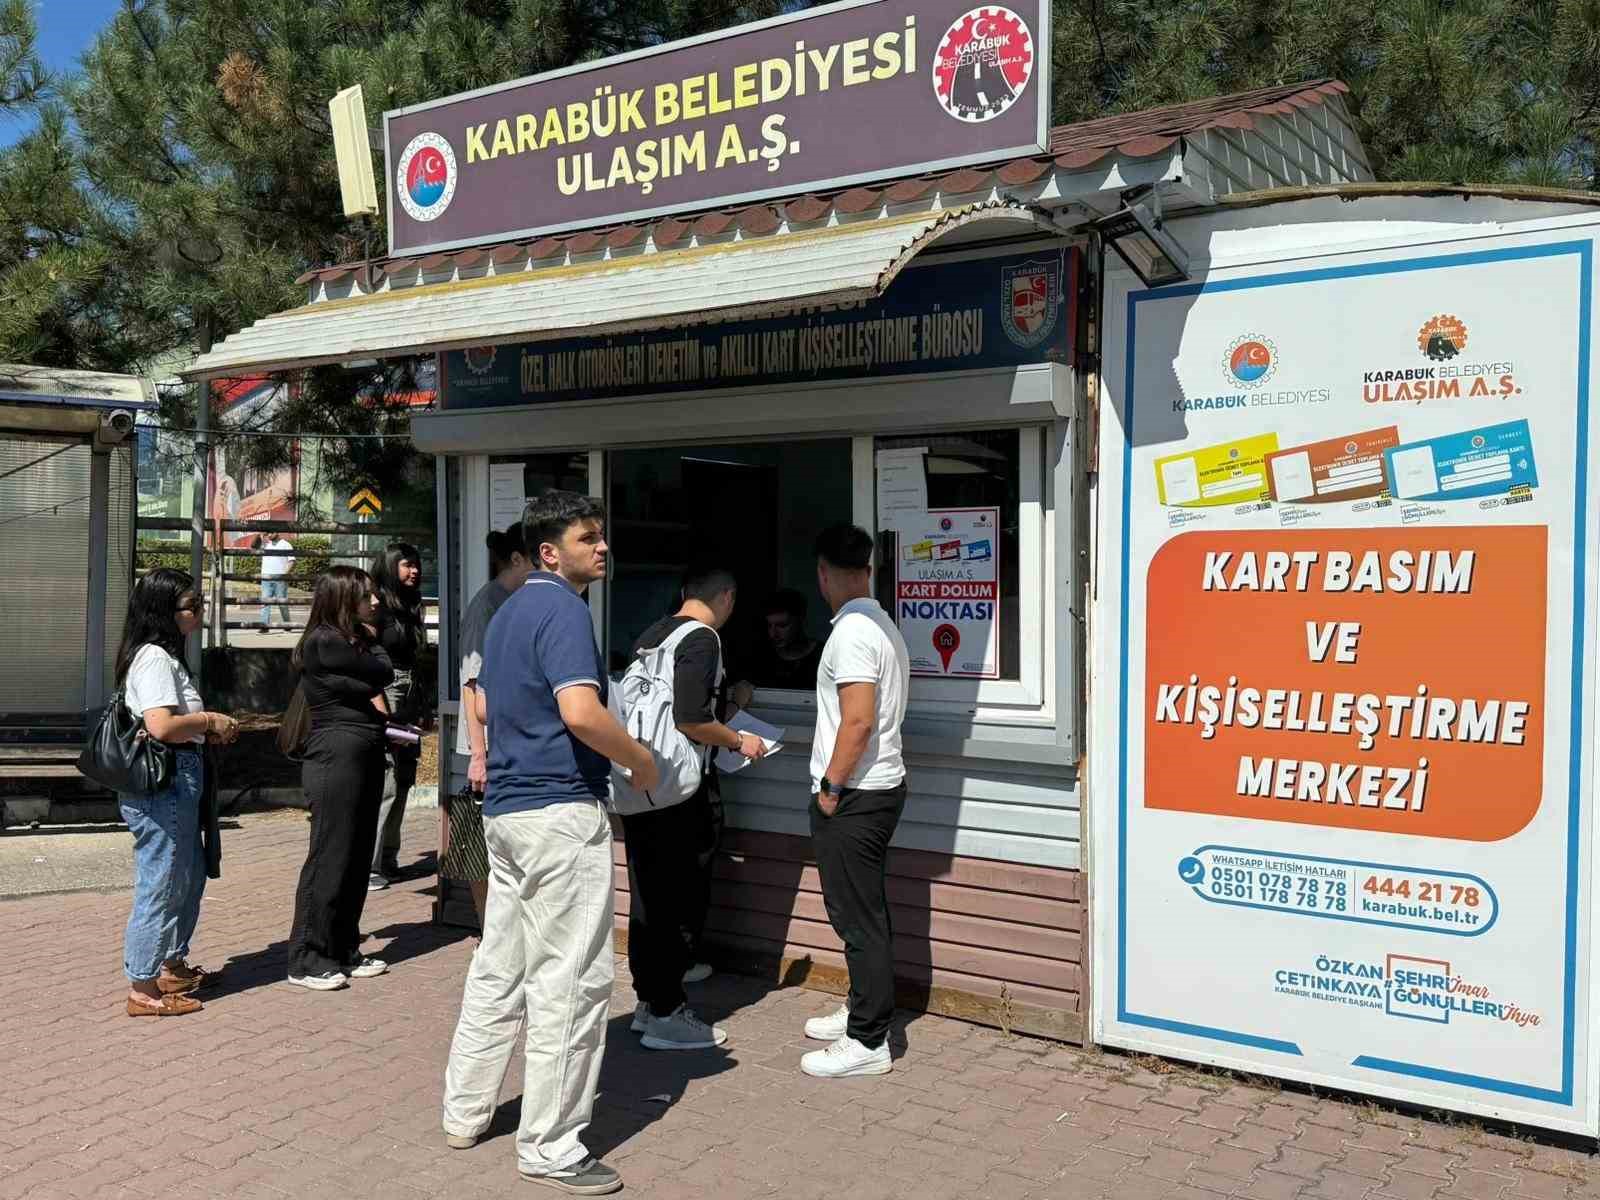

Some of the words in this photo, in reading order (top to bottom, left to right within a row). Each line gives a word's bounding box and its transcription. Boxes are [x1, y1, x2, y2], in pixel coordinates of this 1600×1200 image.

[465, 85, 647, 163] KARABÜK
[655, 15, 916, 126] BELEDİYESİ
[557, 130, 706, 195] ULAŞIM
[715, 113, 800, 172] A.Ş.
[520, 348, 546, 394] ÖZEL
[548, 351, 576, 392] HALK
[578, 335, 645, 389] OTOBÜSLERİ
[703, 345, 718, 379] ve
[720, 331, 759, 376] AKILLI
[763, 328, 796, 373] KART
[800, 309, 917, 377] KİŞİSELLEŞTİRME
[921, 303, 983, 359] BÜROSU
[1364, 367, 1435, 383] KARABÜK
[1439, 362, 1513, 378] BELEDİYESİ
[1172, 394, 1246, 412] KARABÜK
[1251, 389, 1330, 407] BELEDİYESİ
[1363, 379, 1460, 405] ULAŞIM
[1469, 375, 1522, 400] A.Ş.
[1202, 551, 1319, 592] KART
[1323, 550, 1475, 593] BASIM
[901, 584, 937, 596] KART
[941, 584, 992, 597] DOLUM
[902, 601, 993, 620] NOKTASI
[1305, 621, 1361, 663] VE
[1155, 673, 1530, 750] KİŞİSELLEŞTİRME
[1236, 756, 1430, 811] MERKEZİ
[1211, 855, 1263, 867] WHATSAPP
[1264, 858, 1303, 873] İLETİŞİM
[1305, 866, 1346, 879] HATLARI
[1212, 867, 1253, 884] 0501
[1259, 872, 1292, 889] 078
[1298, 877, 1319, 893] 78
[1325, 880, 1347, 896] 78
[1212, 881, 1253, 900] 0501
[1260, 887, 1289, 904] 178
[1296, 892, 1317, 908] 78
[1324, 895, 1346, 912] 78
[1363, 875, 1411, 899] 444
[1418, 881, 1442, 903] 21
[1450, 885, 1480, 908] 78
[1362, 897, 1479, 925] karabuk.bel.tr
[1316, 954, 1384, 980] ÖZKAN
[1275, 970, 1382, 999] ÇETİNKAYA
